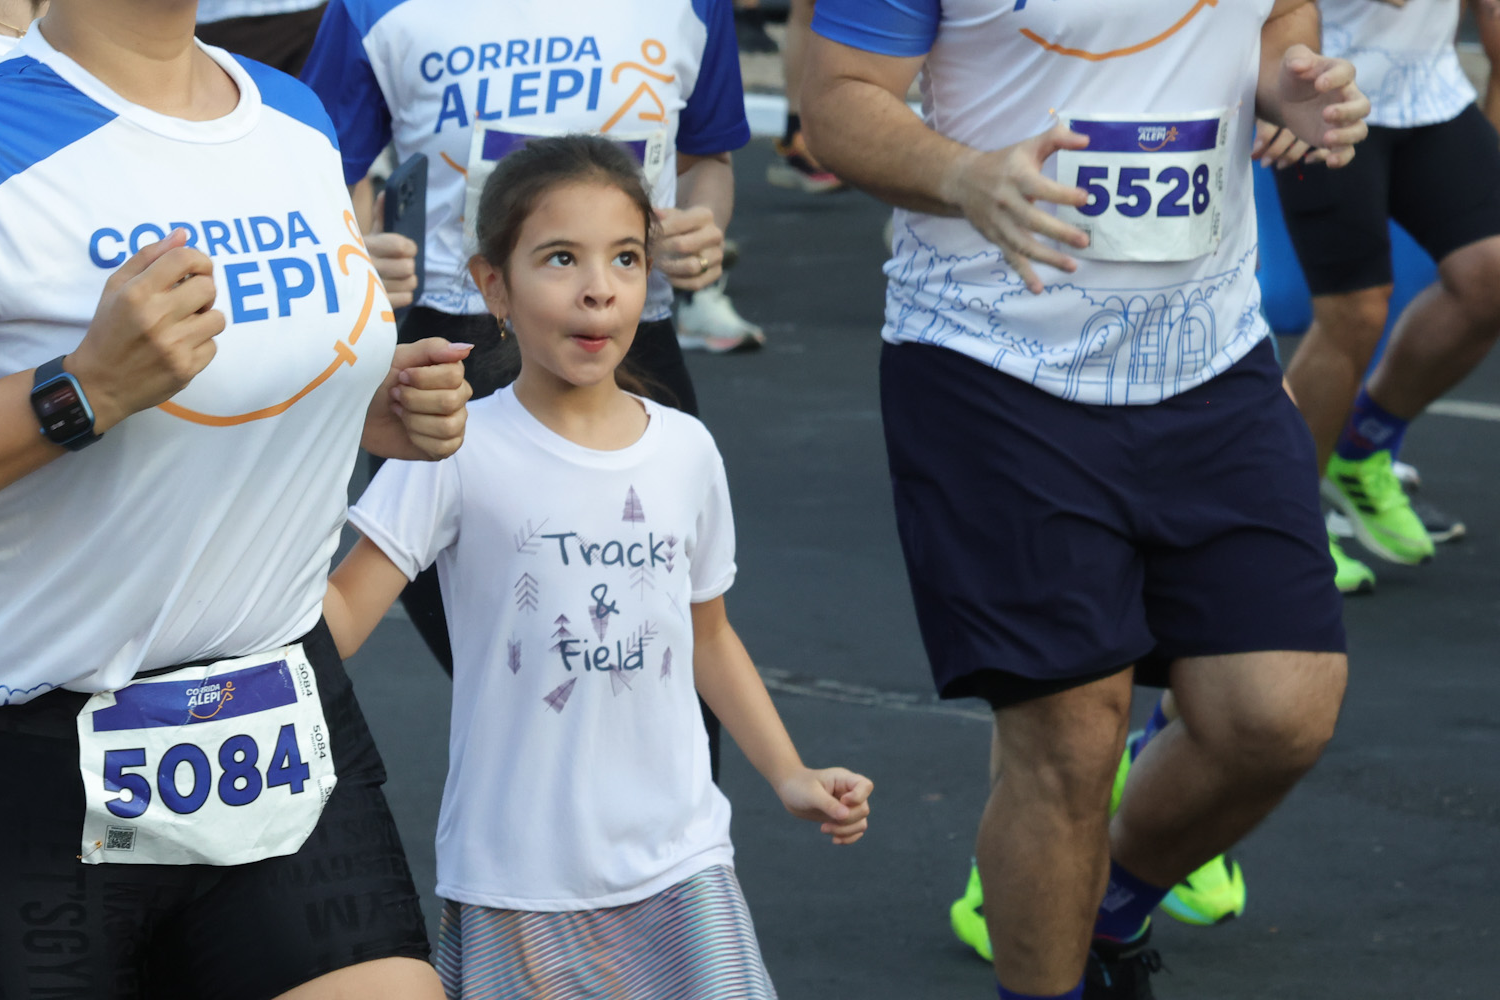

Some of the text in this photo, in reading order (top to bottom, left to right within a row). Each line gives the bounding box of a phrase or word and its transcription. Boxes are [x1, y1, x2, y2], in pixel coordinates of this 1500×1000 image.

[420, 36, 602, 83] CORRIDA
[433, 67, 603, 134] ALEPI
[1137, 131, 1167, 142] ALEPI
[1074, 164, 1211, 218] 5528
[88, 211, 321, 269] CORRIDA
[224, 253, 340, 324] EPI
[541, 532, 667, 568] Track
[591, 583, 620, 619] &
[561, 637, 644, 672] Field
[297, 663, 313, 697] 5084
[187, 690, 221, 707] ALEPI
[312, 724, 327, 760] 5084
[103, 723, 311, 819] 5084
